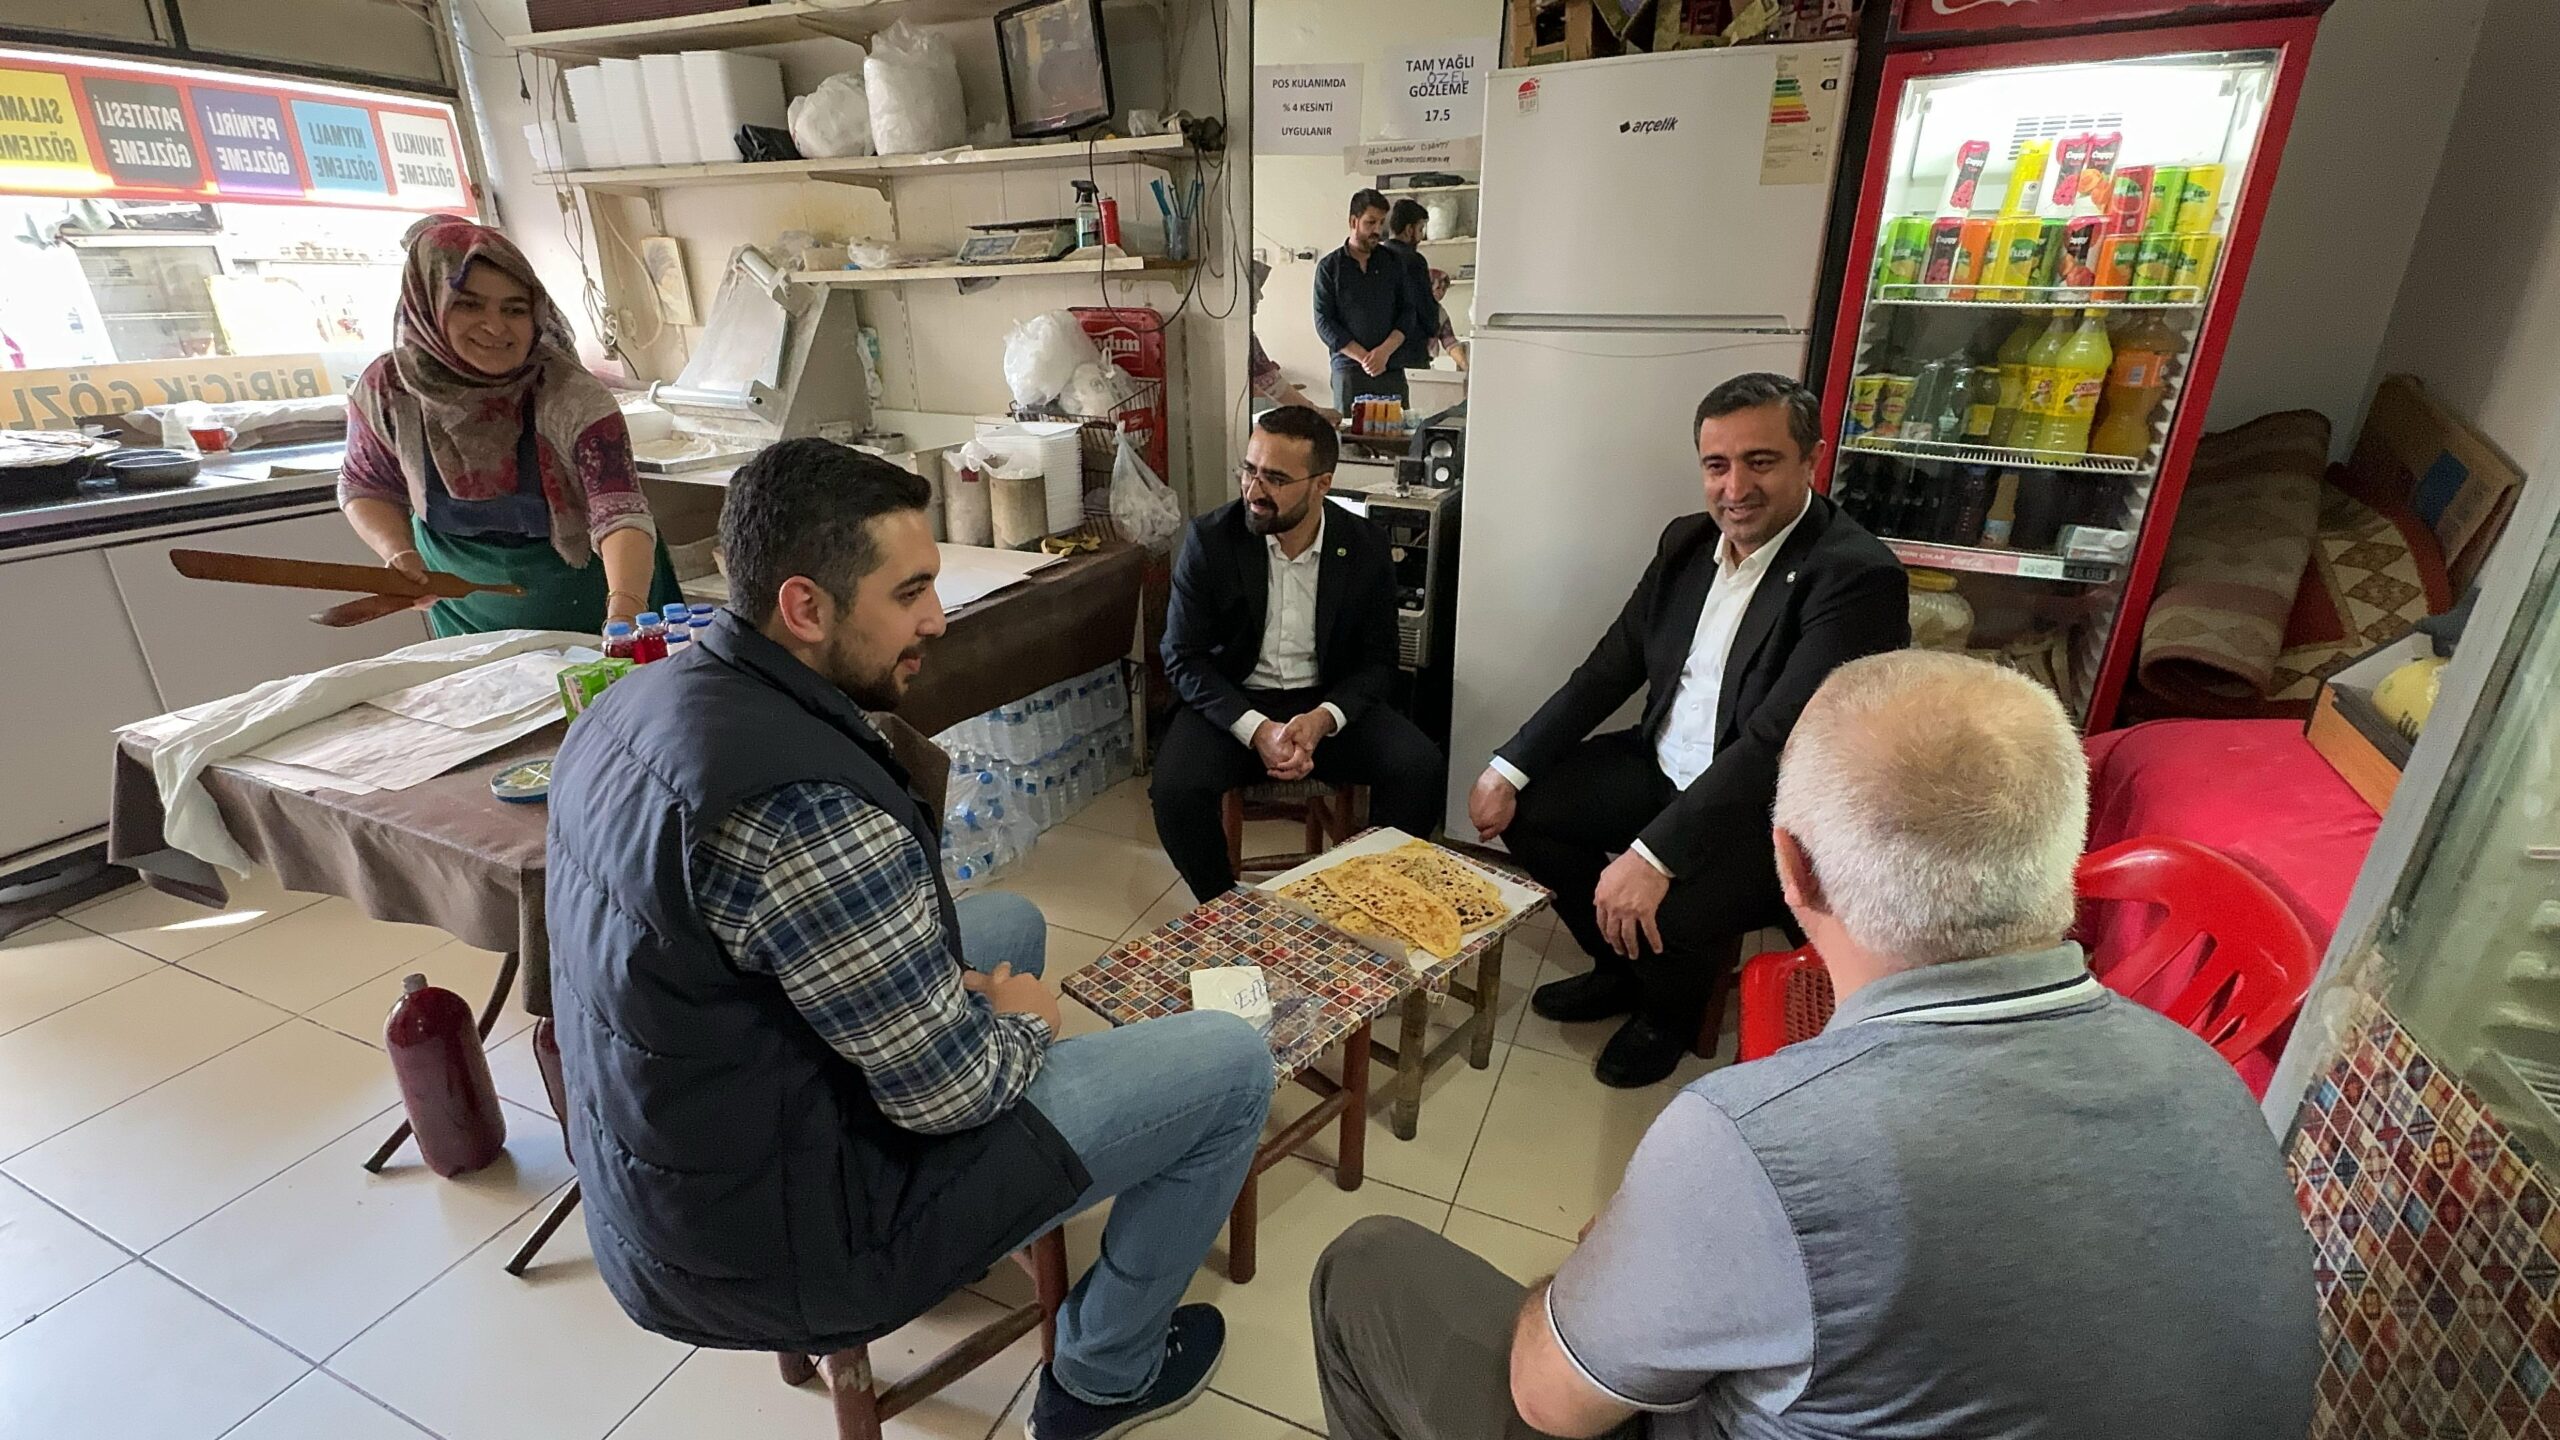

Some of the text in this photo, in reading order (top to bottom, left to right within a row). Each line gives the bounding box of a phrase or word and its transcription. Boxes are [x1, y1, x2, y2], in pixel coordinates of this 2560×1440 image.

[1406, 54, 1475, 72] TAM YAĞLI
[1272, 78, 1346, 88] POS KULANIMDA
[1409, 83, 1469, 98] GÖZLEME
[1292, 103, 1298, 112] 4
[1300, 101, 1333, 112] KESİNTİ
[1425, 109, 1450, 122] 17.5
[1281, 127, 1332, 136] UYGULANIR
[1632, 116, 1679, 134] arçelik
